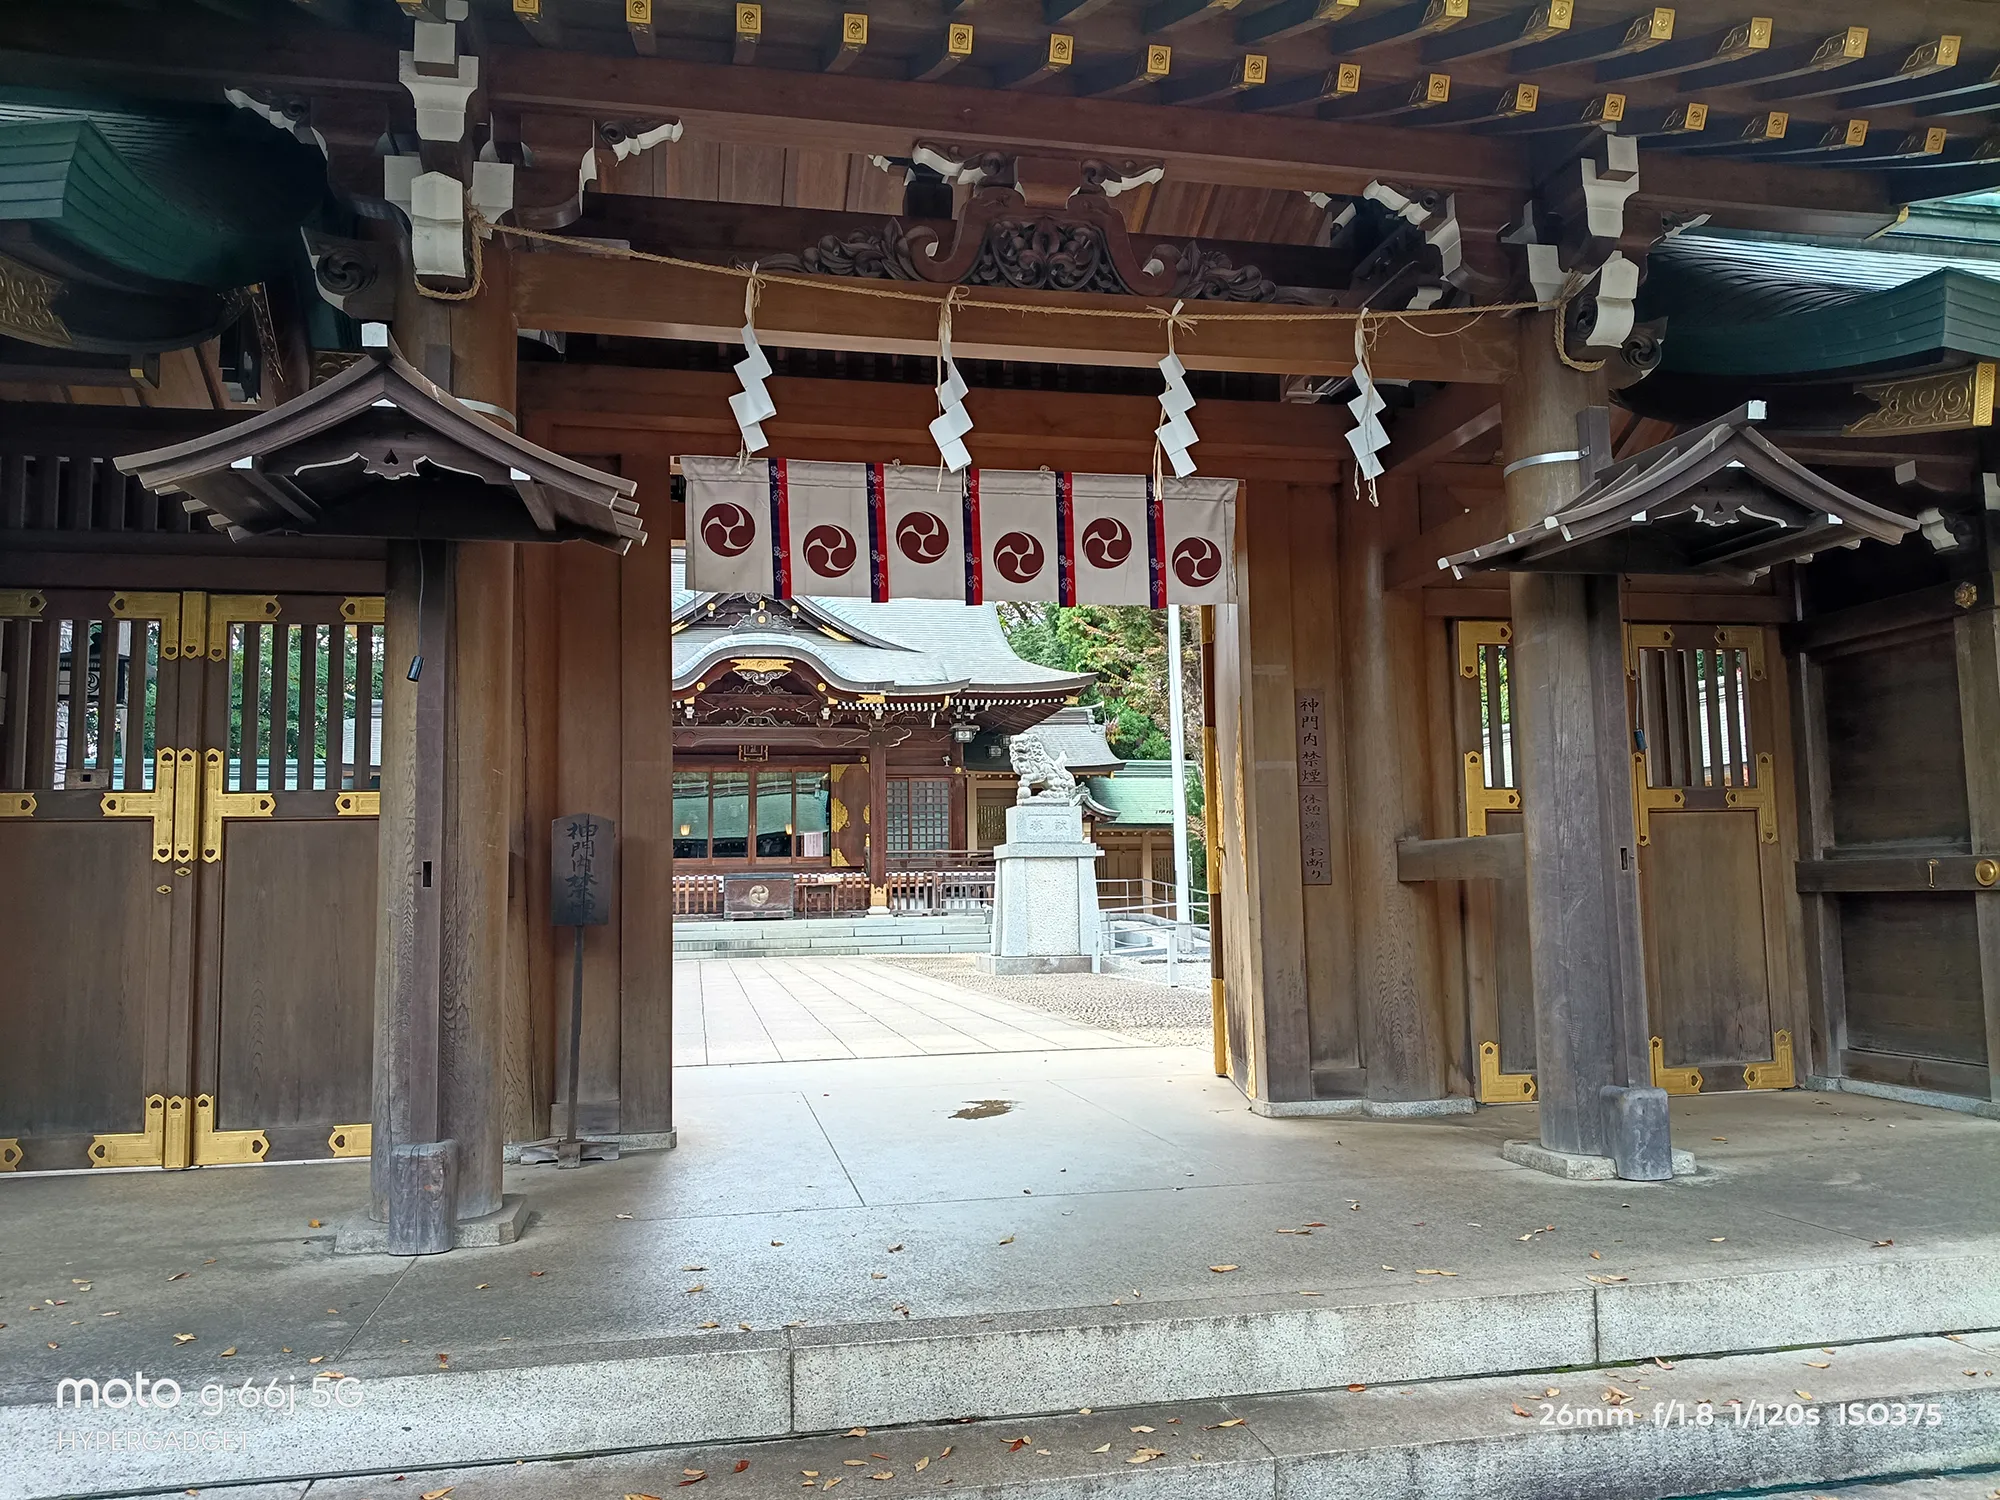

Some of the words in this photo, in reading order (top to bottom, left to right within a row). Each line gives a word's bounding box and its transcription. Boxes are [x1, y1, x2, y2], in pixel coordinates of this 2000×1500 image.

[1299, 697, 1322, 784] 神門内禁煙
